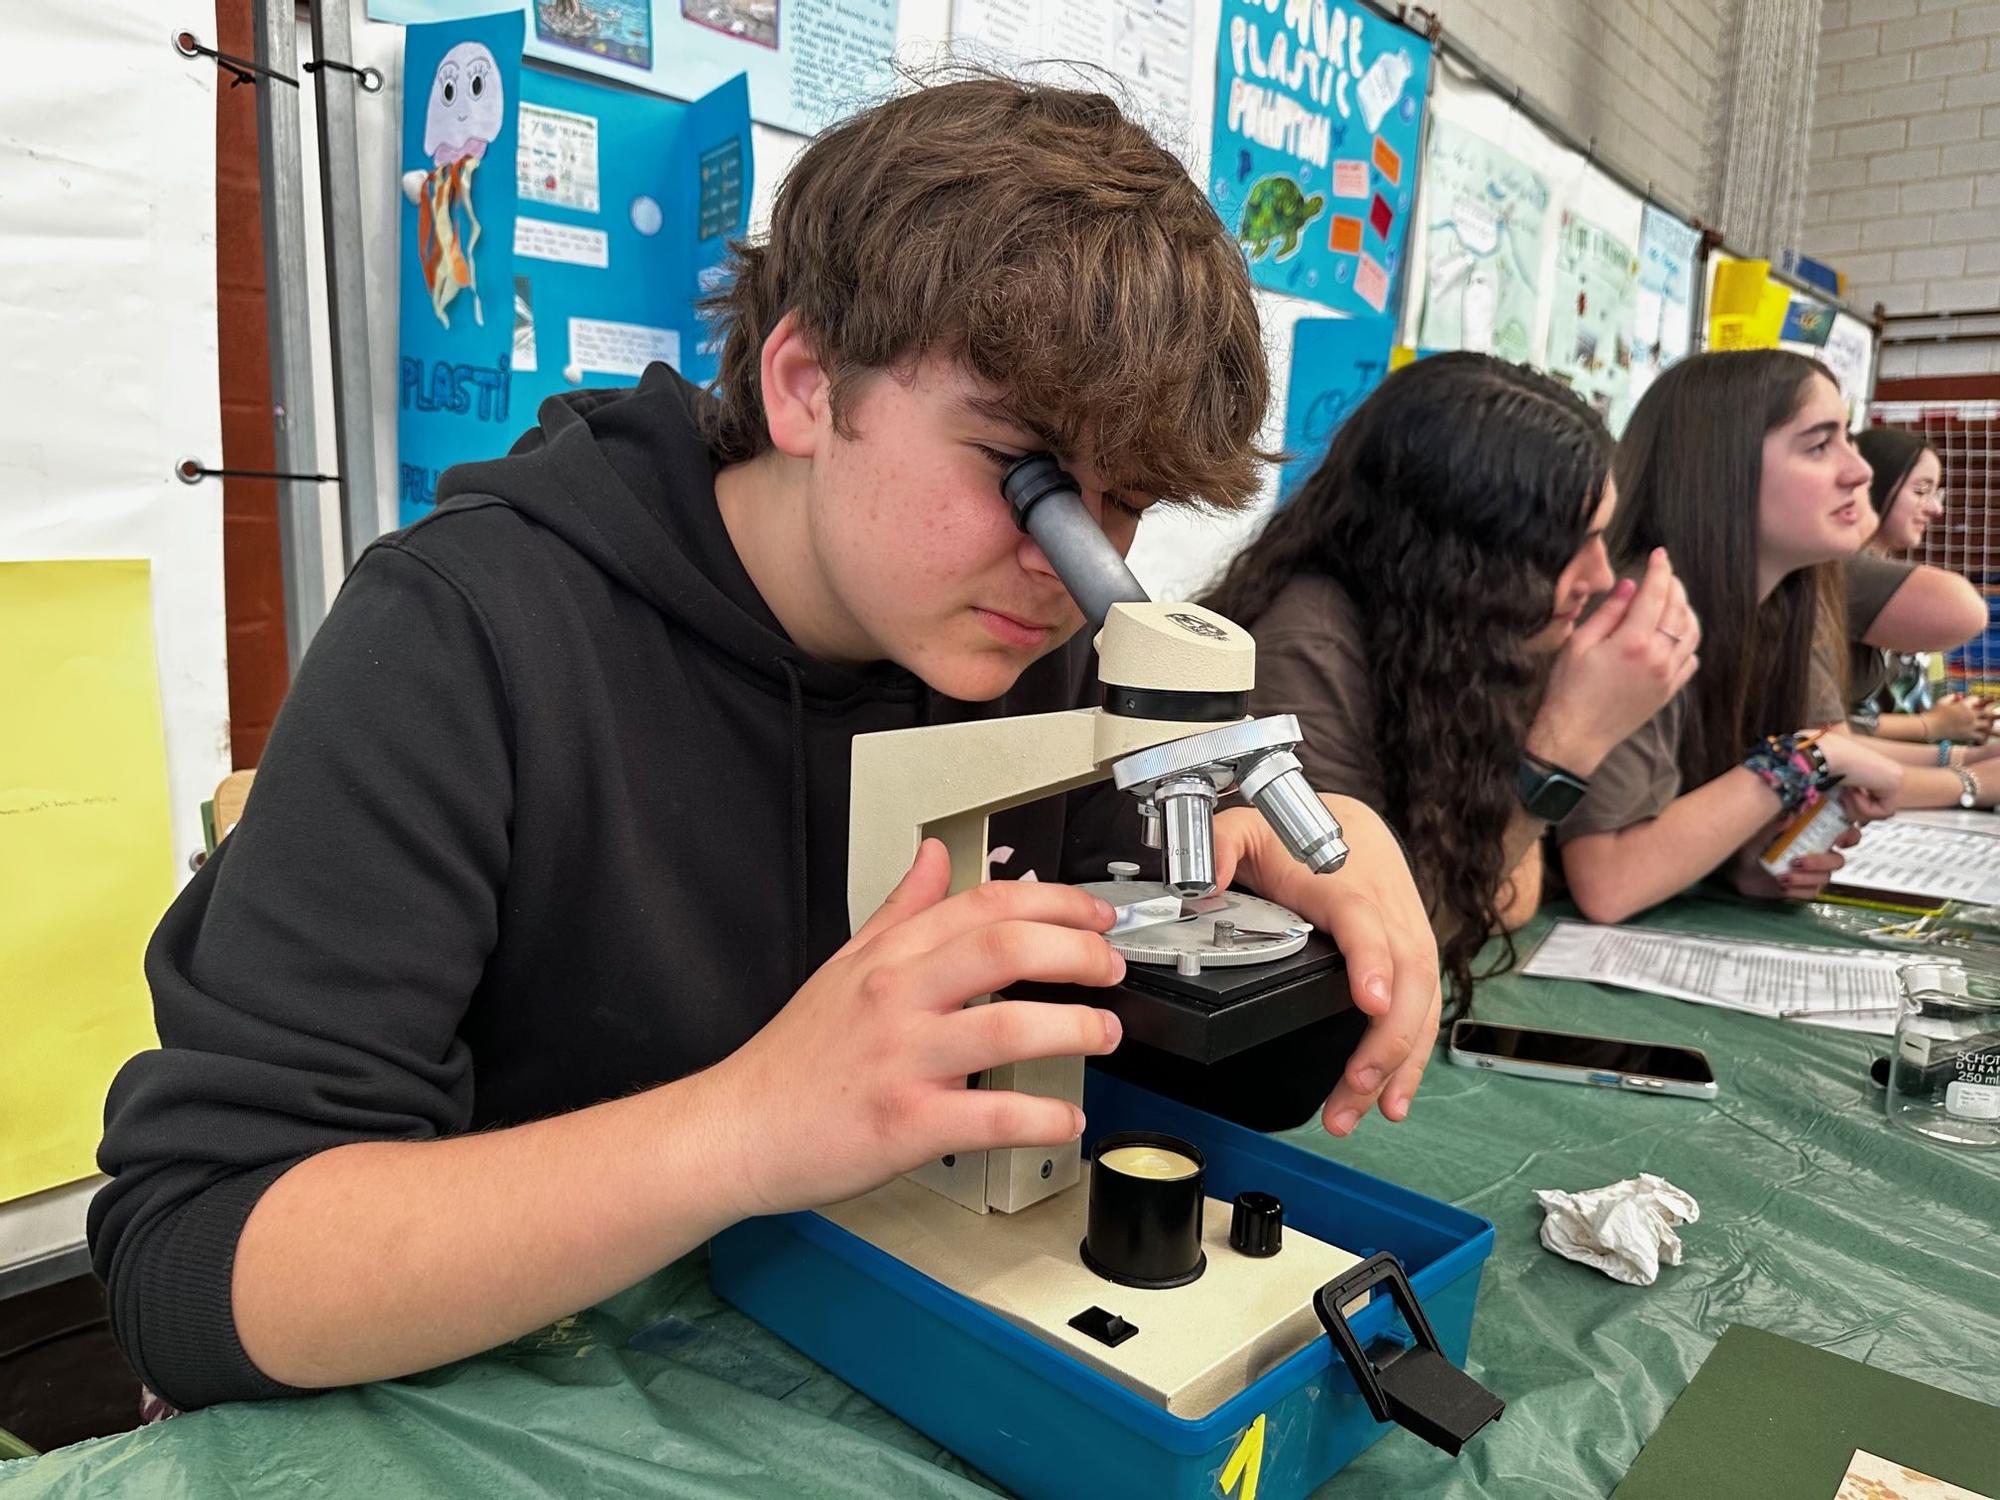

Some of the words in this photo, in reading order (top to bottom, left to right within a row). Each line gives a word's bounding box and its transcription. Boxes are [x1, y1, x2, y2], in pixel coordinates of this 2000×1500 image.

[1231, 16, 1350, 118] PLASTIC
[1958, 1071, 1981, 1083] 250
[1985, 1075, 1999, 1085] ml
